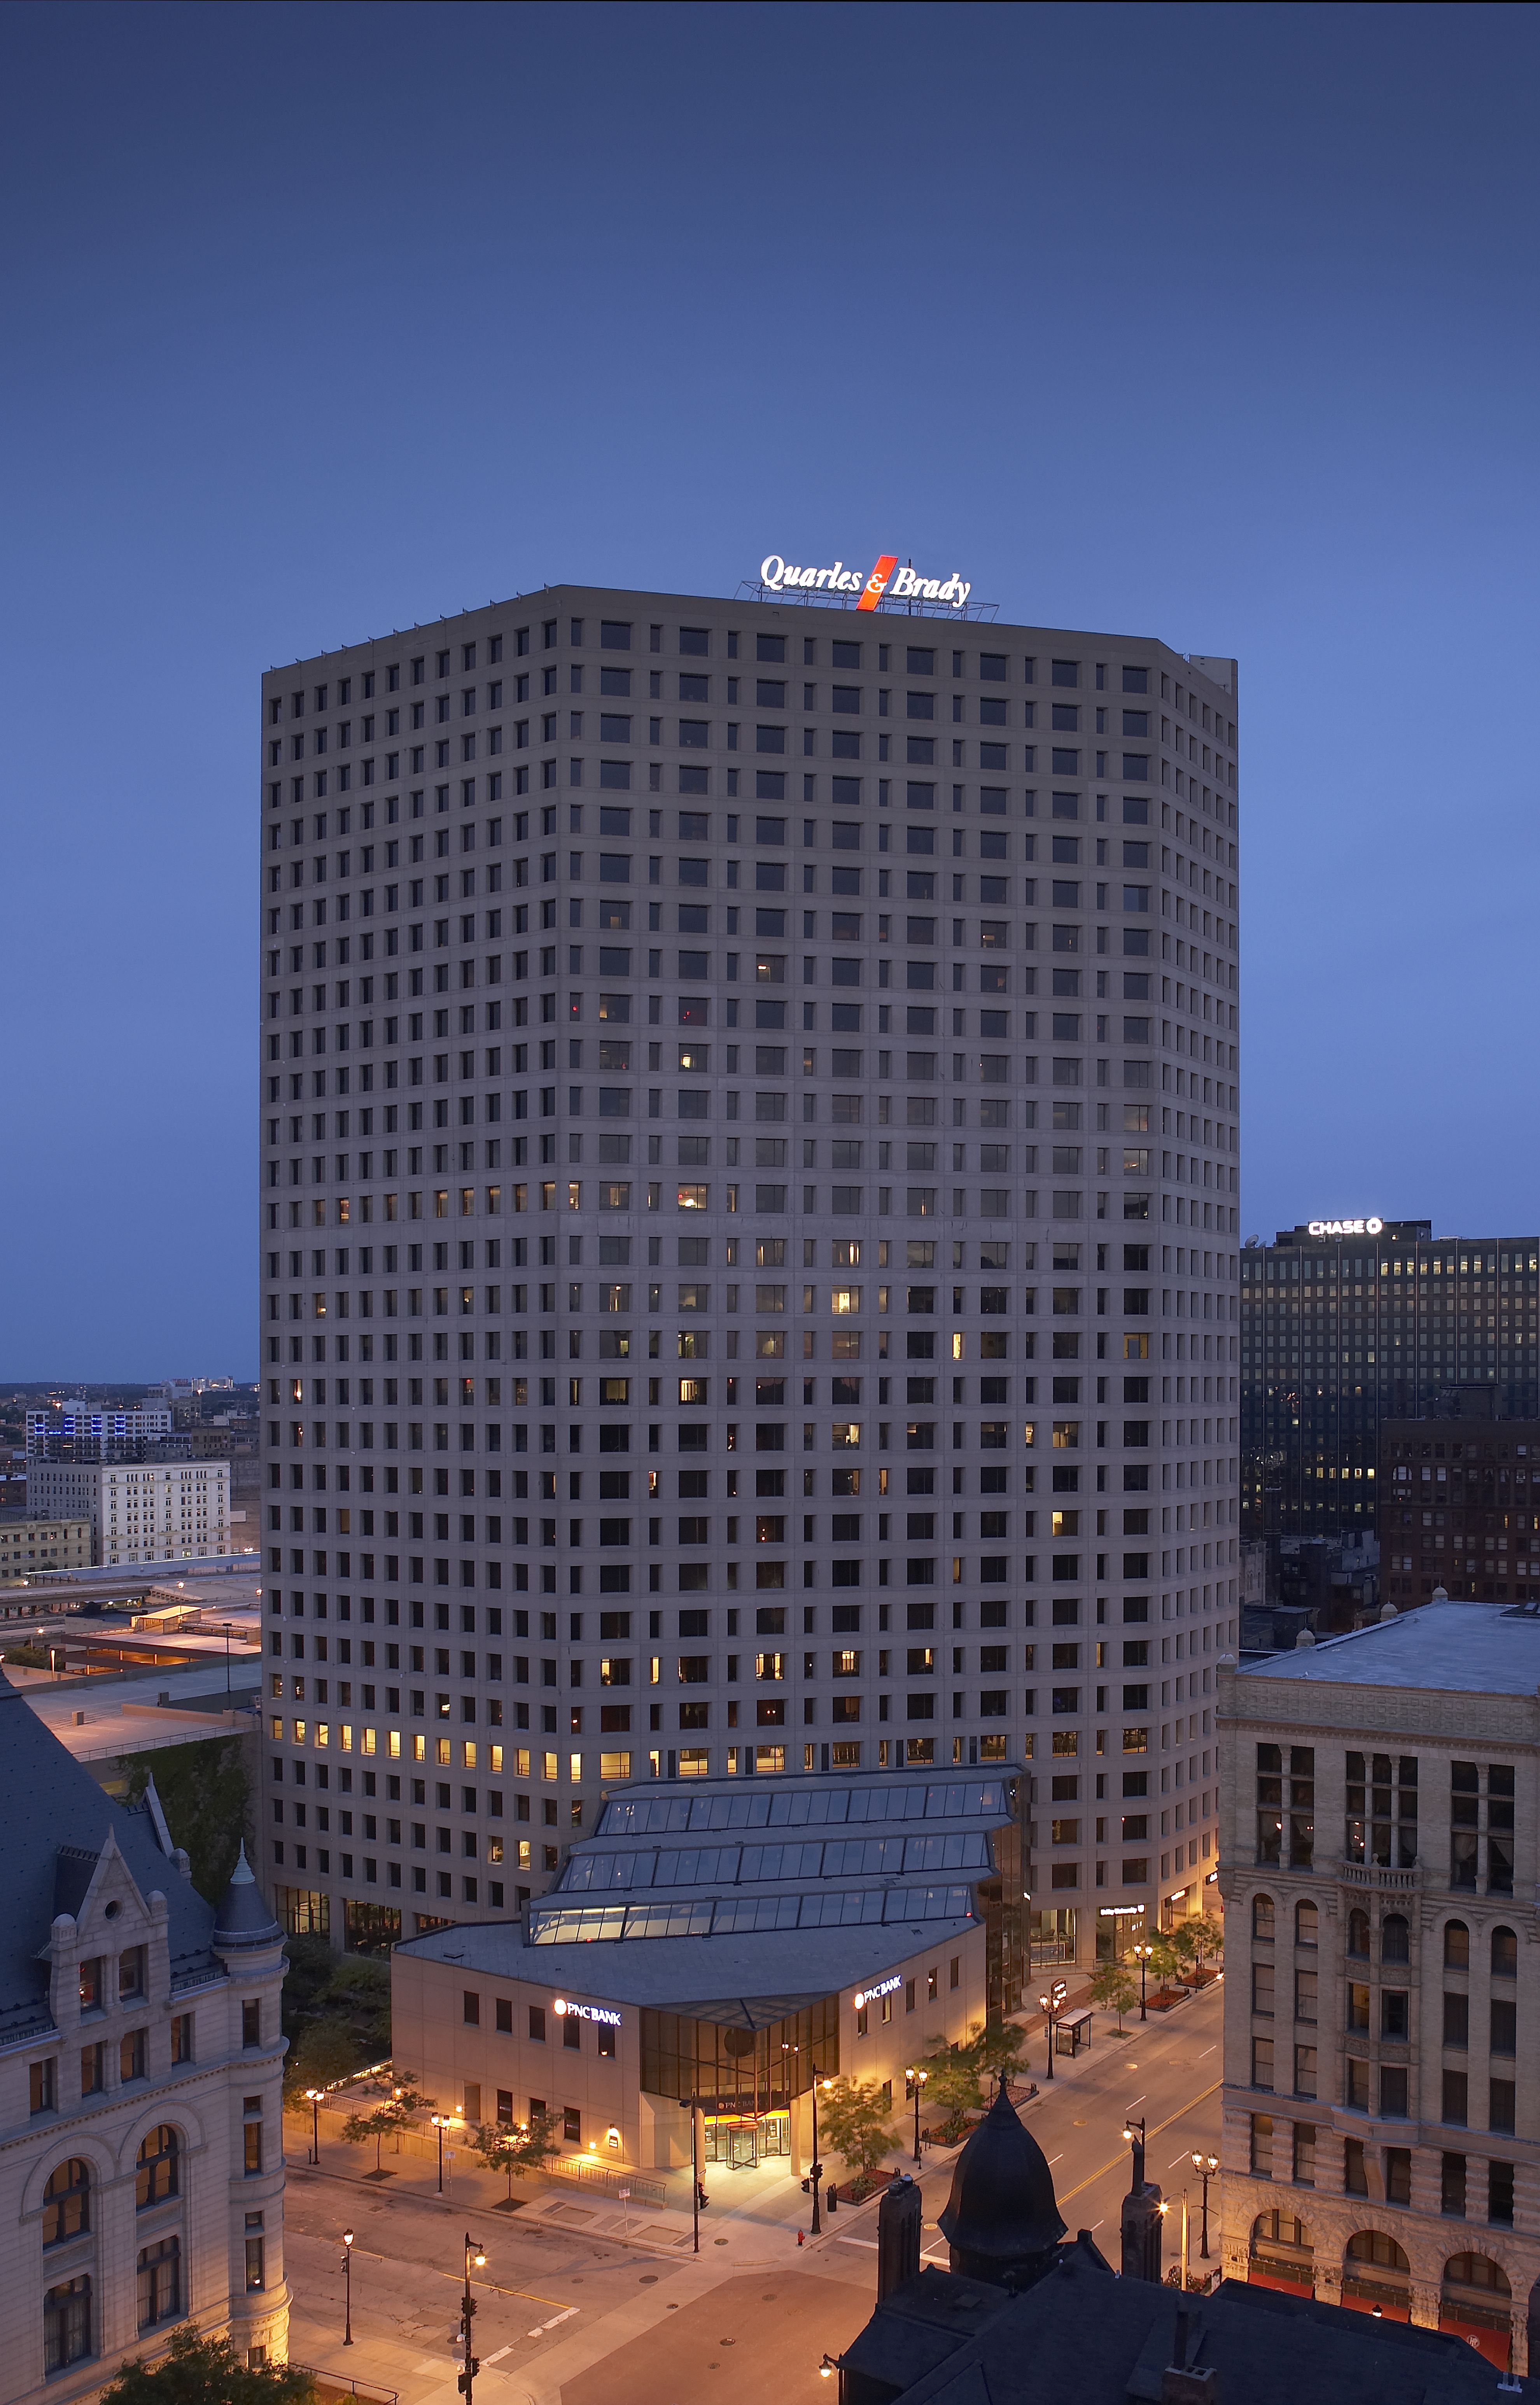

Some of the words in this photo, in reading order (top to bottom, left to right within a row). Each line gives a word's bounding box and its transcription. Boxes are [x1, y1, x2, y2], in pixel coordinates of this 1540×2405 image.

[761, 555, 863, 591] Quarles
[866, 573, 887, 593] &
[890, 567, 971, 607] Brady
[1308, 1220, 1365, 1236] CHASE
